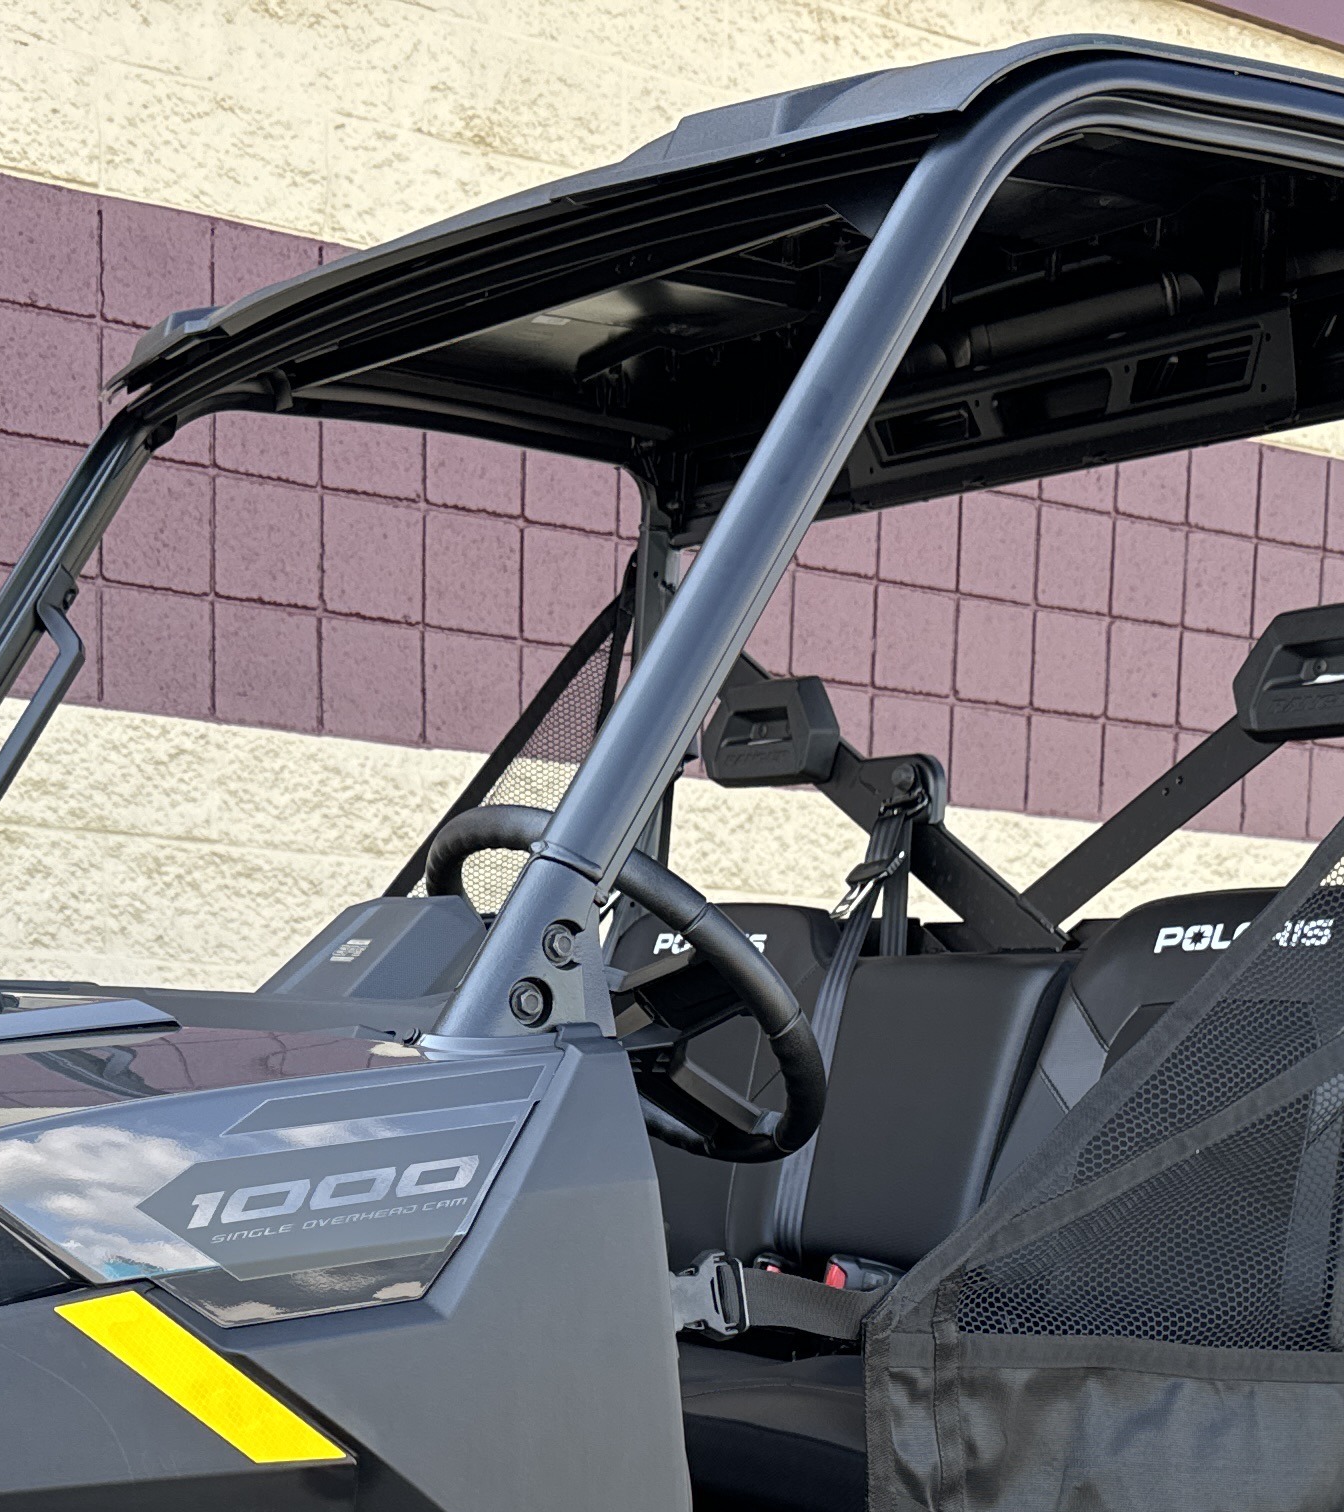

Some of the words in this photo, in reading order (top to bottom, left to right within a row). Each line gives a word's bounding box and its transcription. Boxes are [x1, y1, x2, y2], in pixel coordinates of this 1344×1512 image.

[187, 1155, 480, 1229] 1000
[211, 1223, 295, 1244] SINGLE
[302, 1204, 418, 1229] OVERHEAD
[421, 1197, 469, 1212] CAM
